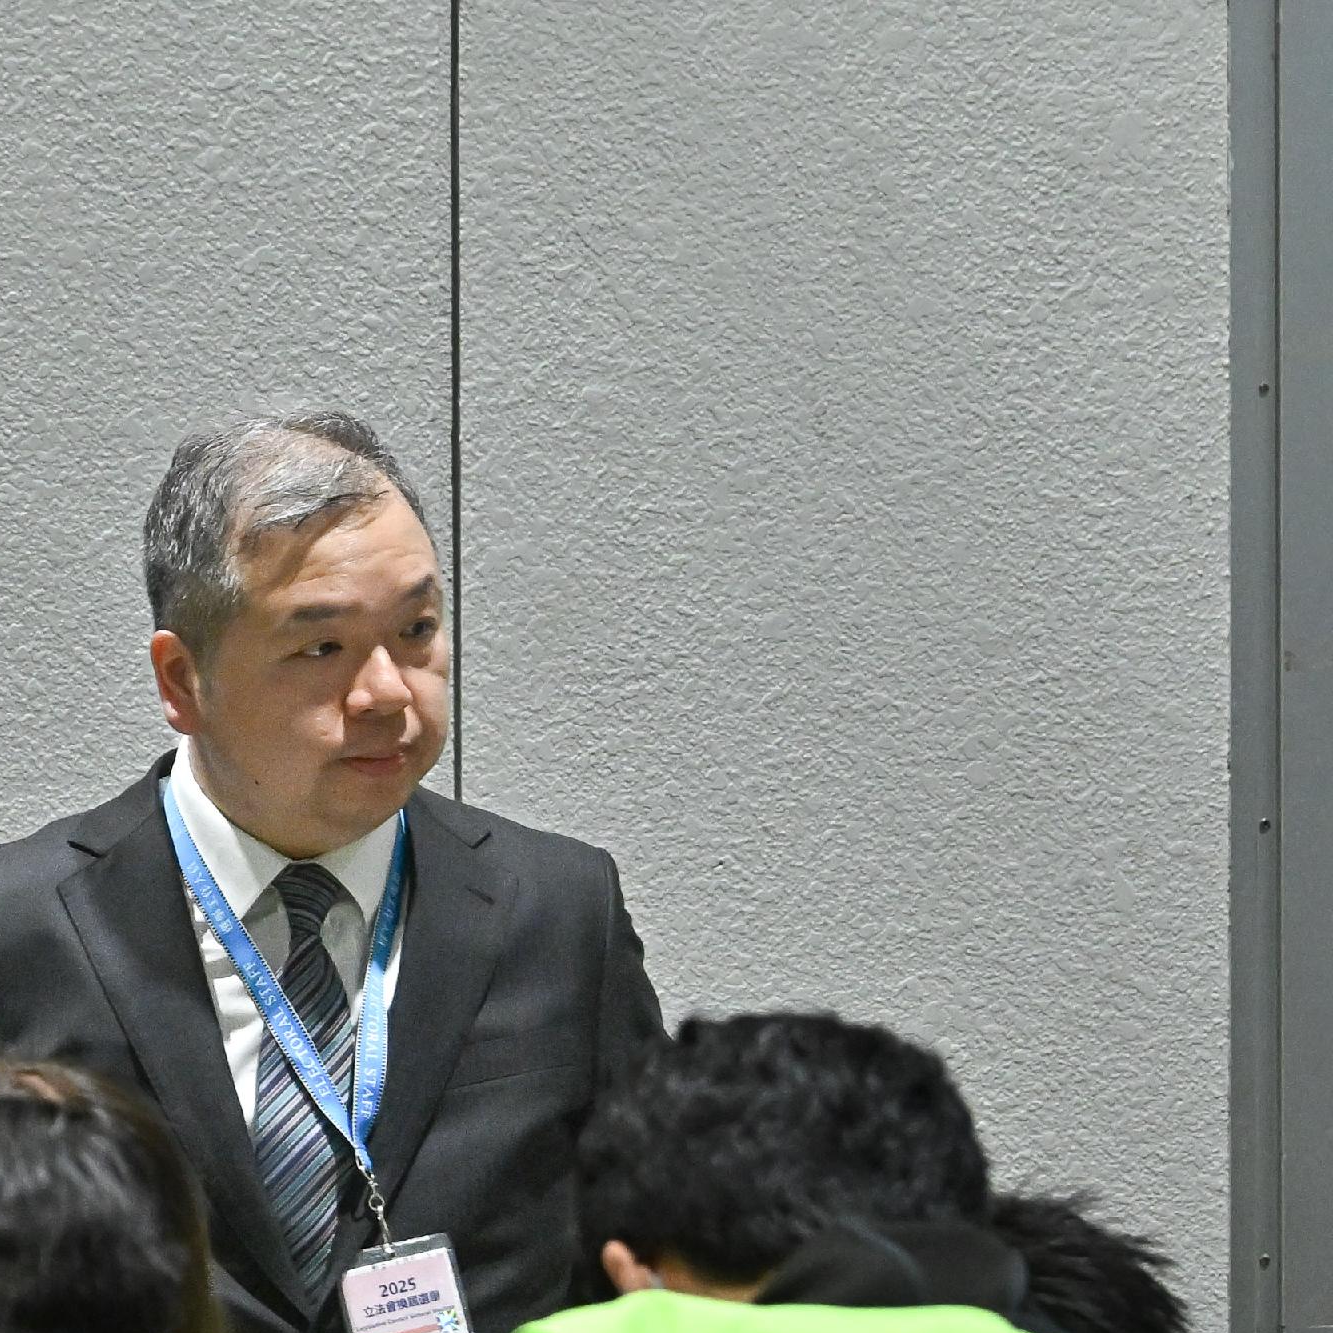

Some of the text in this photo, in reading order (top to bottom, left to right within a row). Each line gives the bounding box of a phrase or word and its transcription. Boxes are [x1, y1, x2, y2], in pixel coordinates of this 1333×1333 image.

[244, 961, 332, 1098] ELECTORAL STAFF
[360, 1068, 377, 1119] STAFF
[378, 1277, 417, 1297] 2025
